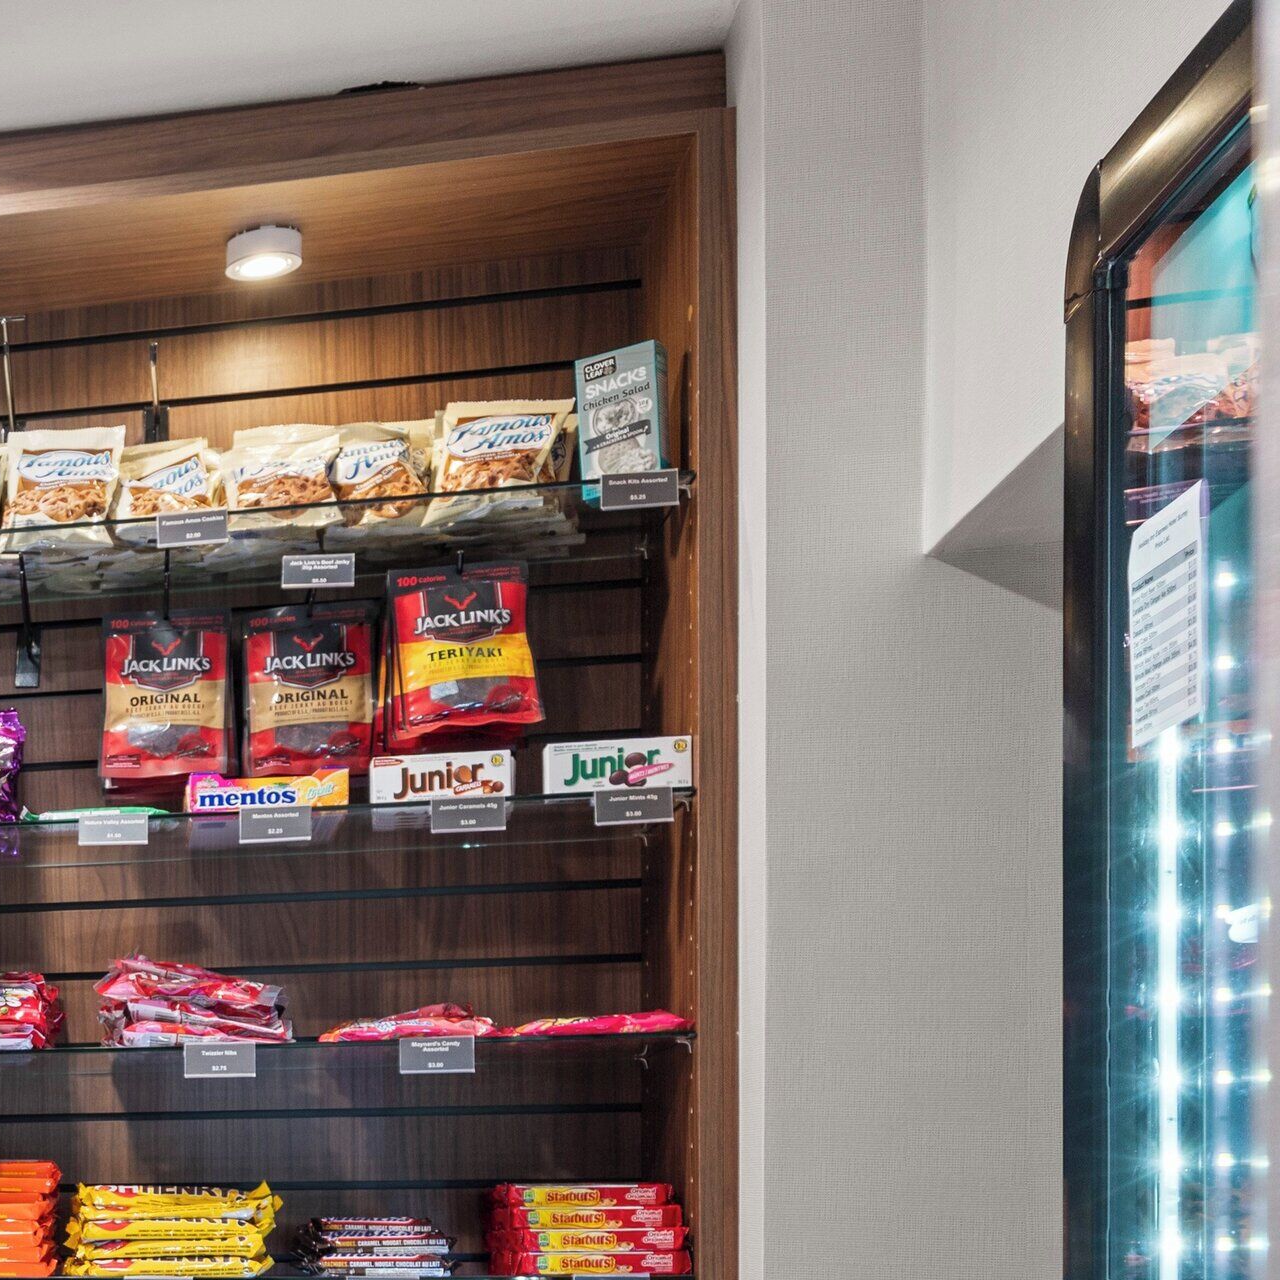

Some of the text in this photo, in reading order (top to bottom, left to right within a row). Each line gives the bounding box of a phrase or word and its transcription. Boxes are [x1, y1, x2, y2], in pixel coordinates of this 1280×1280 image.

[584, 359, 615, 373] CLOVER
[585, 370, 603, 380] LEAF
[585, 366, 647, 400] SNACKS
[583, 382, 651, 412] Chicken Salad
[448, 413, 552, 448] Famous
[462, 429, 548, 453] Amos
[22, 450, 111, 470] Famous
[40, 466, 108, 479] Amos
[201, 515, 225, 523] Cookies
[396, 576, 417, 587] 100
[111, 619, 129, 629] 100
[248, 617, 268, 628] 100
[414, 609, 511, 635] JACK LINK'S
[427, 646, 503, 662] TERIYAKI
[121, 656, 211, 676] JACK LINK'S
[263, 652, 356, 674] JACK LINK'S
[130, 693, 201, 706] ORIGINAL
[274, 689, 349, 704] ORIGINAL
[563, 745, 661, 789] Junior
[392, 761, 486, 801] Junior
[198, 786, 297, 808] mentos
[439, 802, 486, 811] Junior Caramels
[119, 817, 146, 825] Assorted
[271, 811, 299, 819] Assorted
[411, 1040, 461, 1048] Maynard's Candy
[546, 1188, 600, 1204] Starburst
[551, 1209, 605, 1225] Starburst
[561, 1232, 615, 1248] Starburst
[560, 1256, 614, 1272] Starburst
